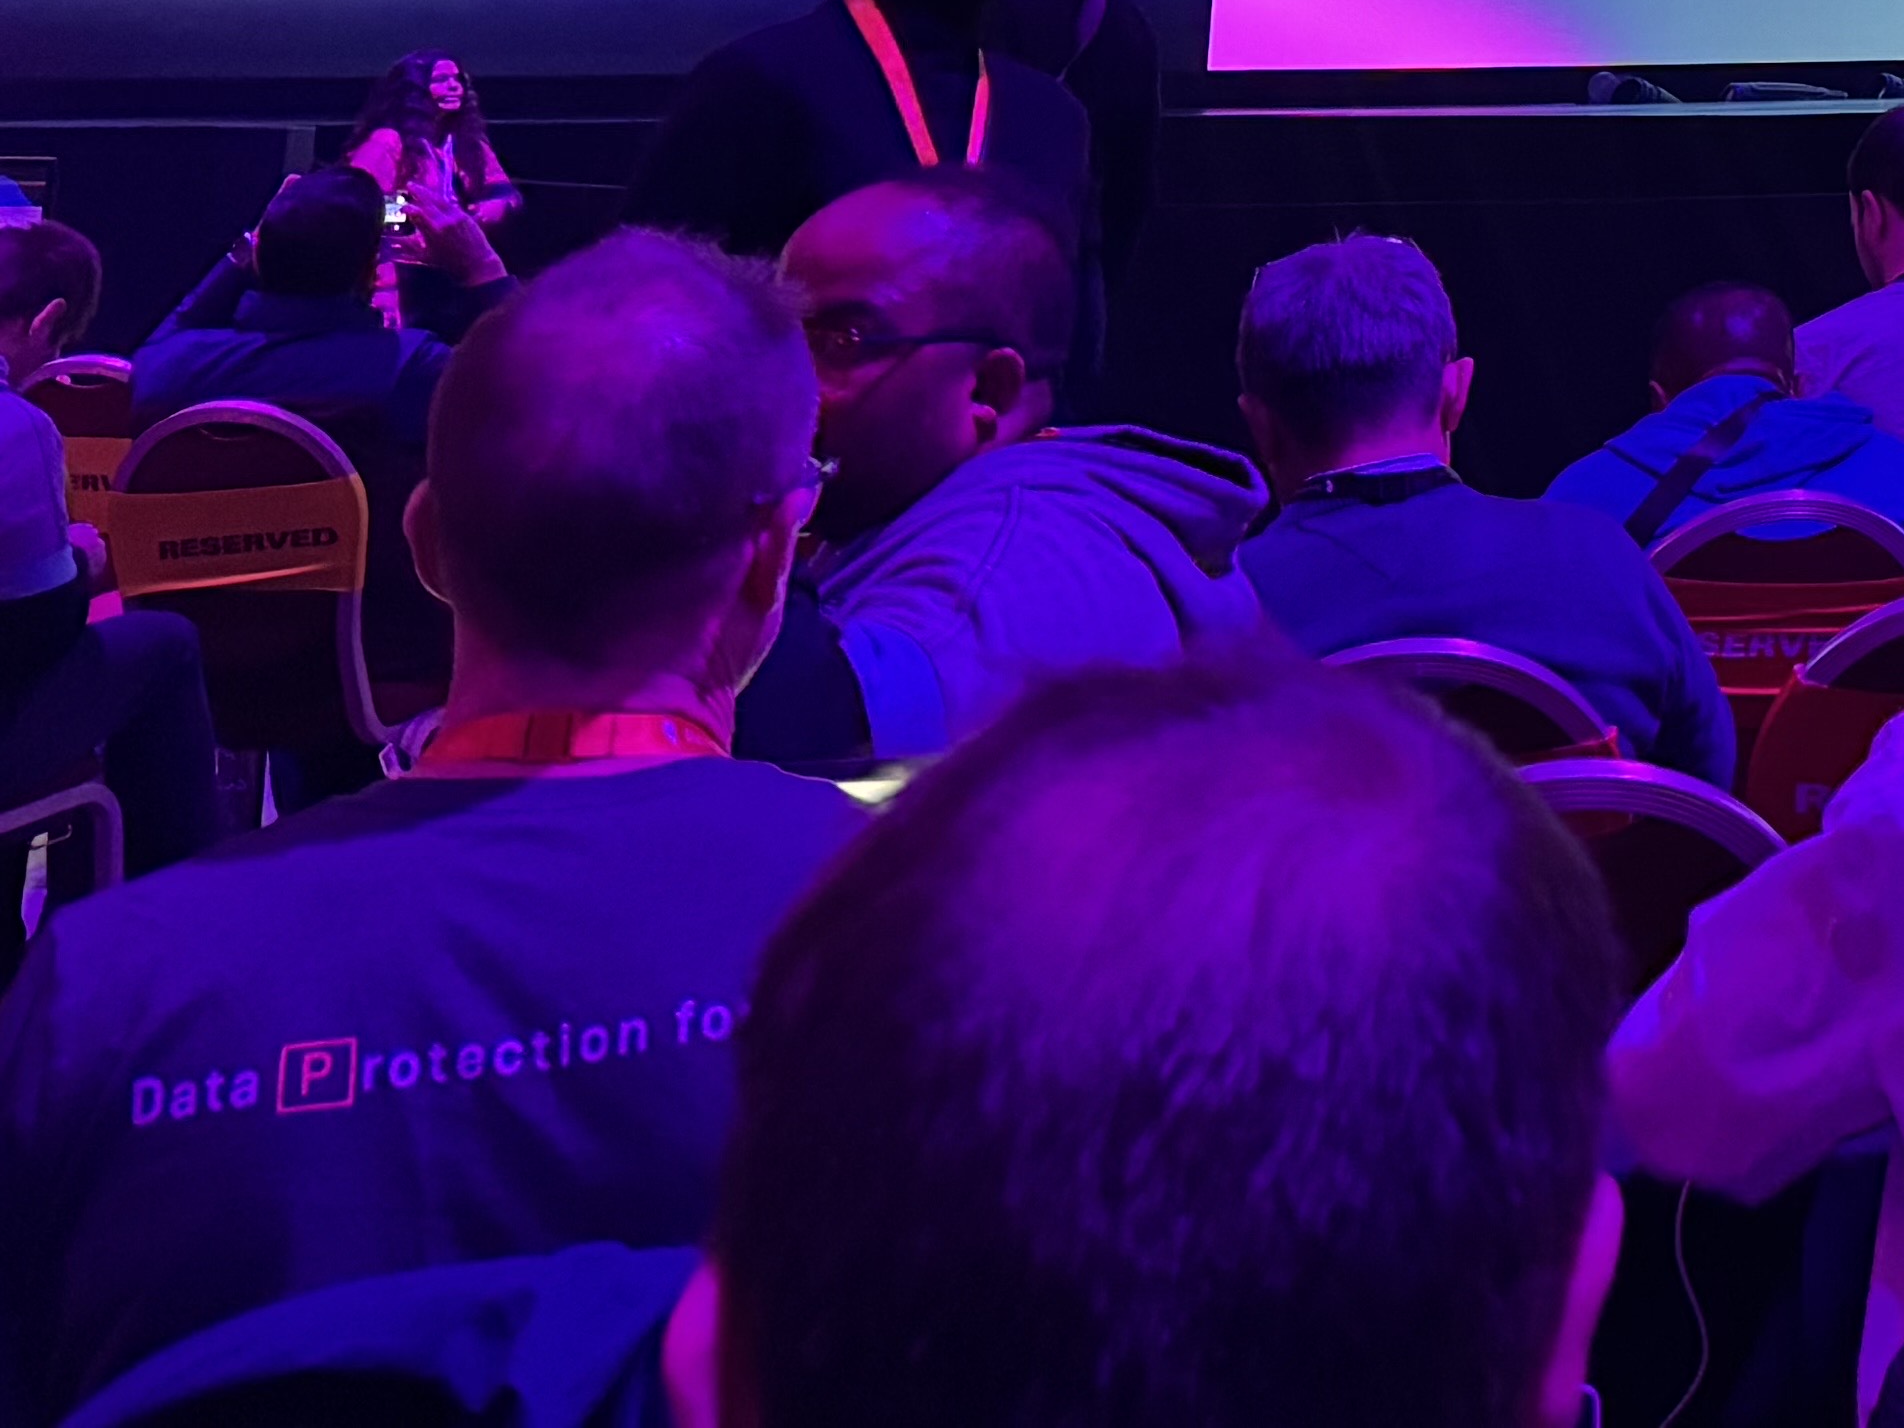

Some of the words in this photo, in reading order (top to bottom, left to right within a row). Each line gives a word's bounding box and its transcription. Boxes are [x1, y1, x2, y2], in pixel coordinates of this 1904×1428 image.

[159, 526, 340, 561] RESERVED
[132, 1069, 260, 1126] Data
[300, 1017, 649, 1097] Protection
